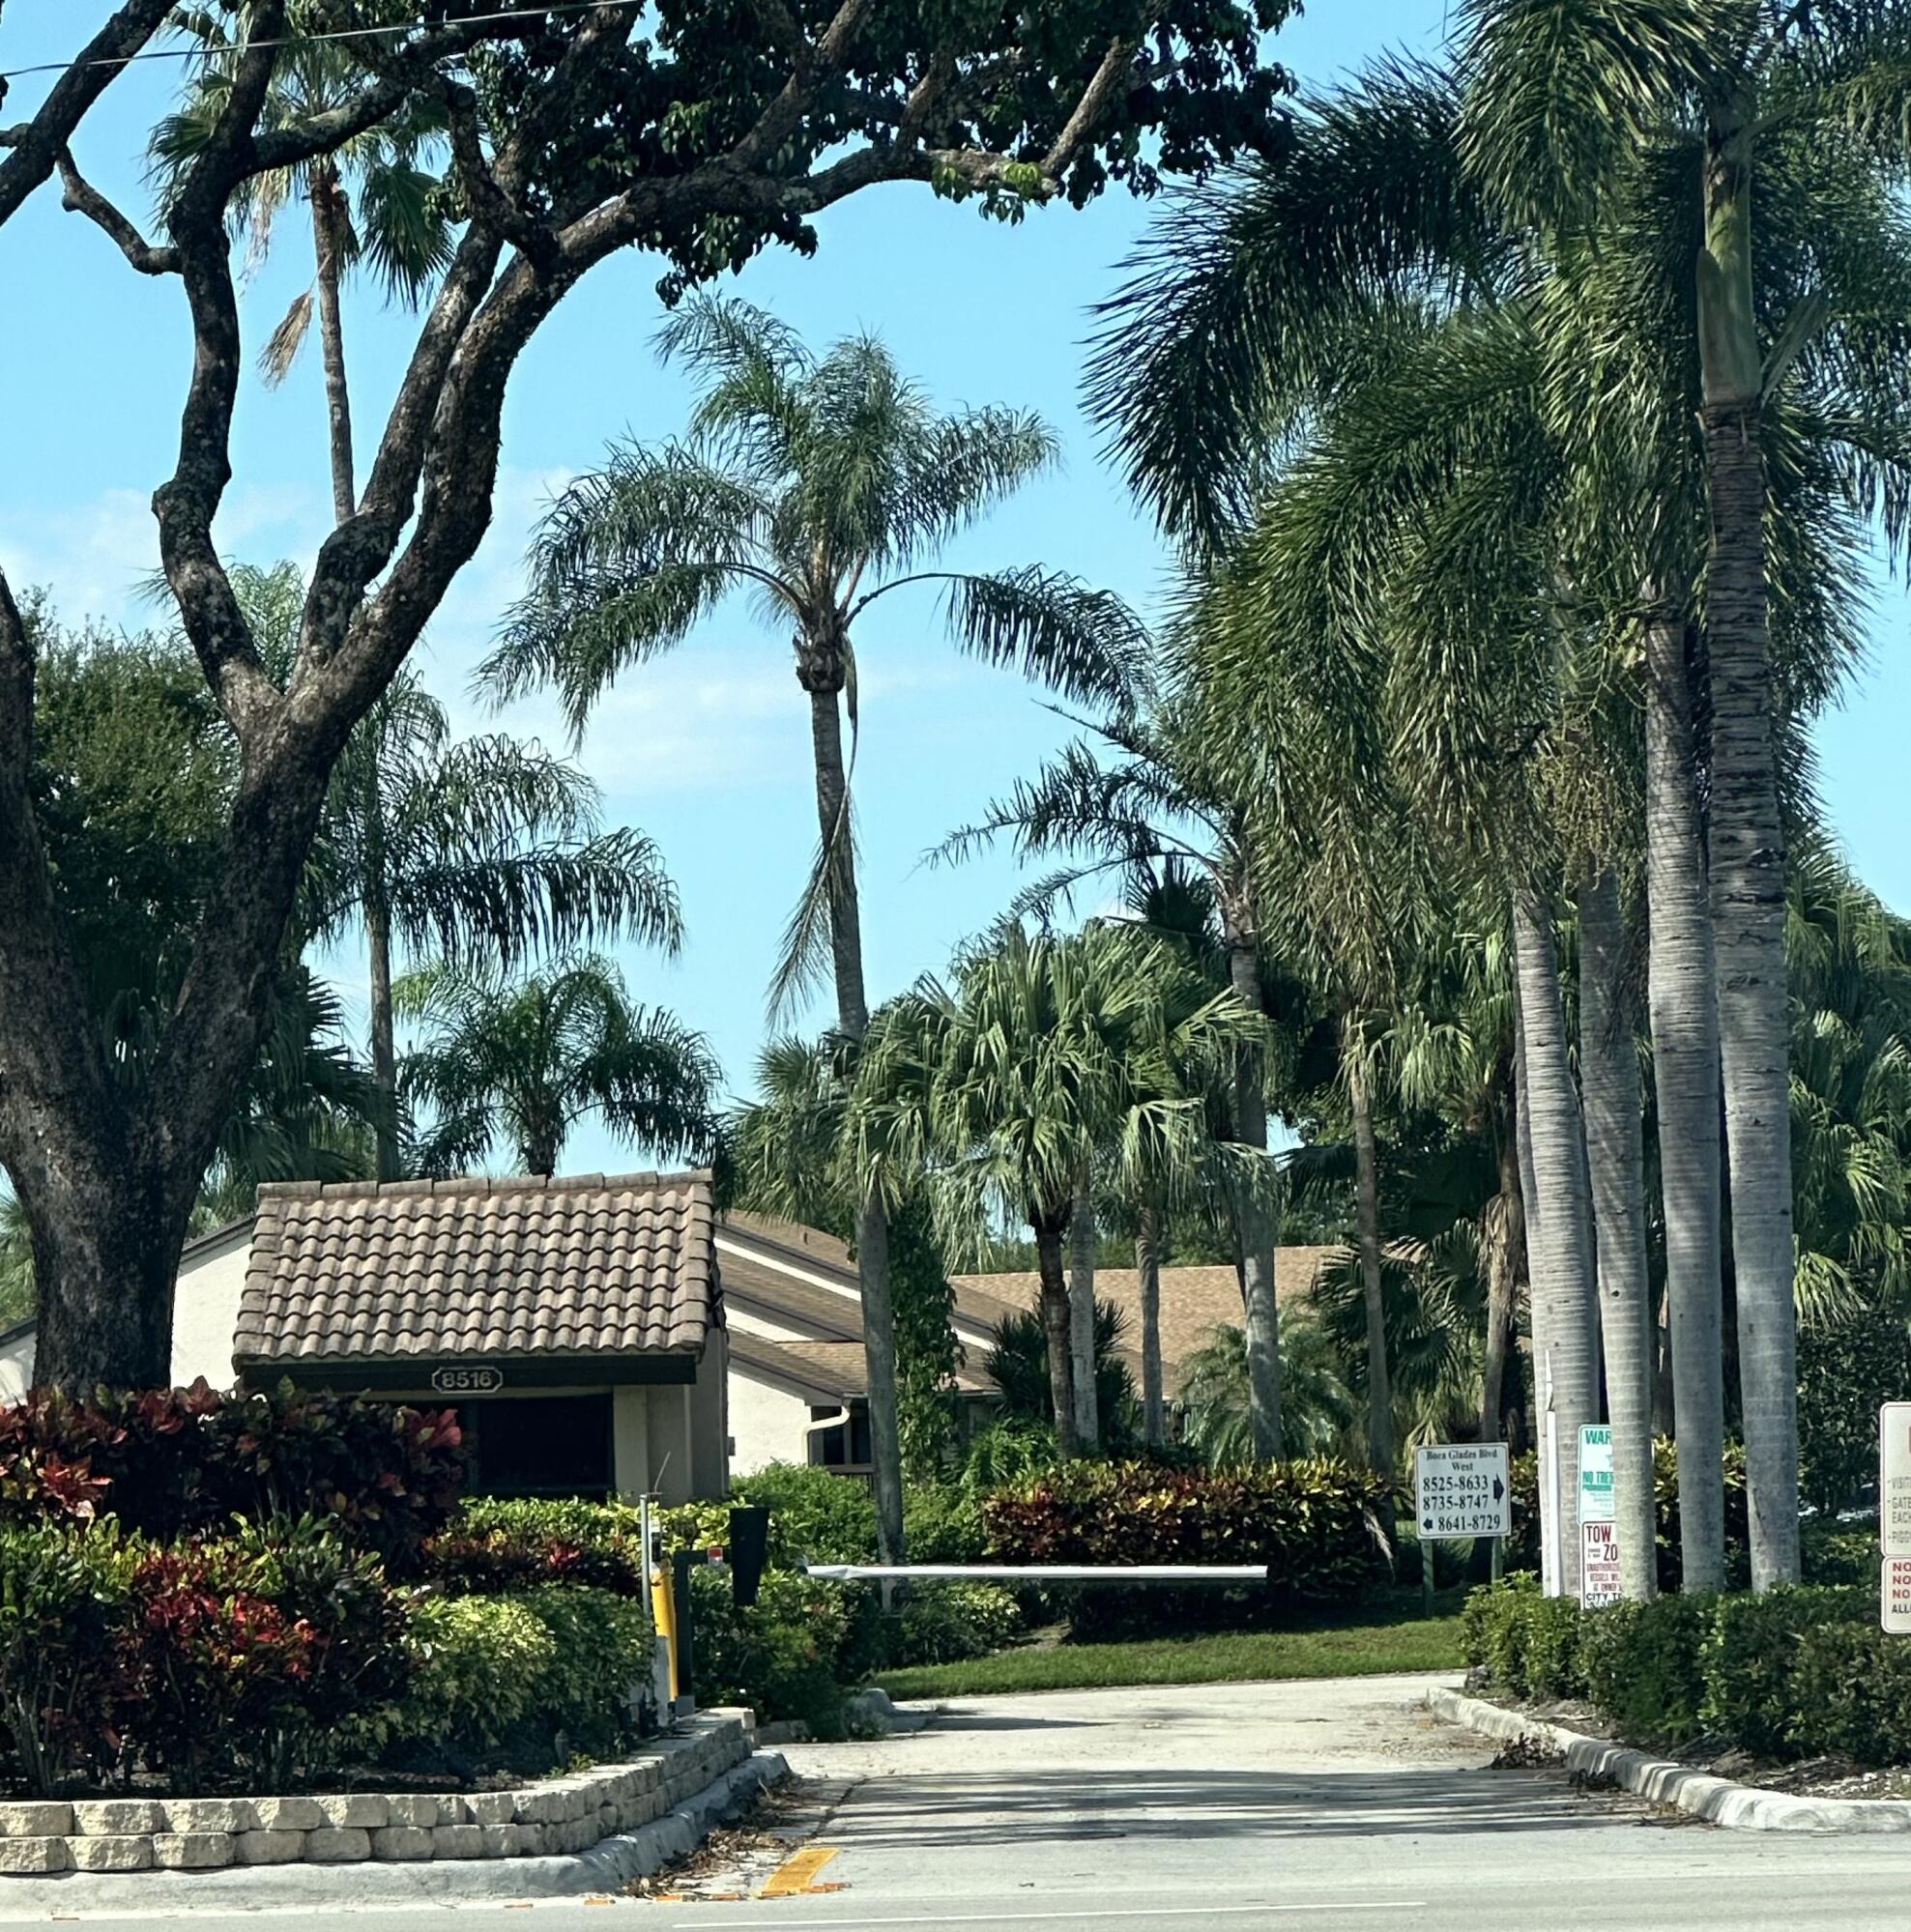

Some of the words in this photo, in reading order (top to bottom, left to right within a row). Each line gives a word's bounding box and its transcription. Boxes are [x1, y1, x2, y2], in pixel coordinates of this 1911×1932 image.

[442, 1371, 492, 1388] 8516
[1448, 1450, 1476, 1460] Glades
[1479, 1449, 1497, 1458] Blvd
[1451, 1461, 1473, 1471] West
[1423, 1474, 1489, 1491] 8525-8633
[1423, 1494, 1489, 1511] 8735-8747
[1437, 1514, 1500, 1531] 8641-8729
[1586, 1525, 1611, 1543] TOW
[1893, 1563, 1911, 1572] NO
[1893, 1575, 1911, 1585] NO
[1893, 1589, 1910, 1599] NO
